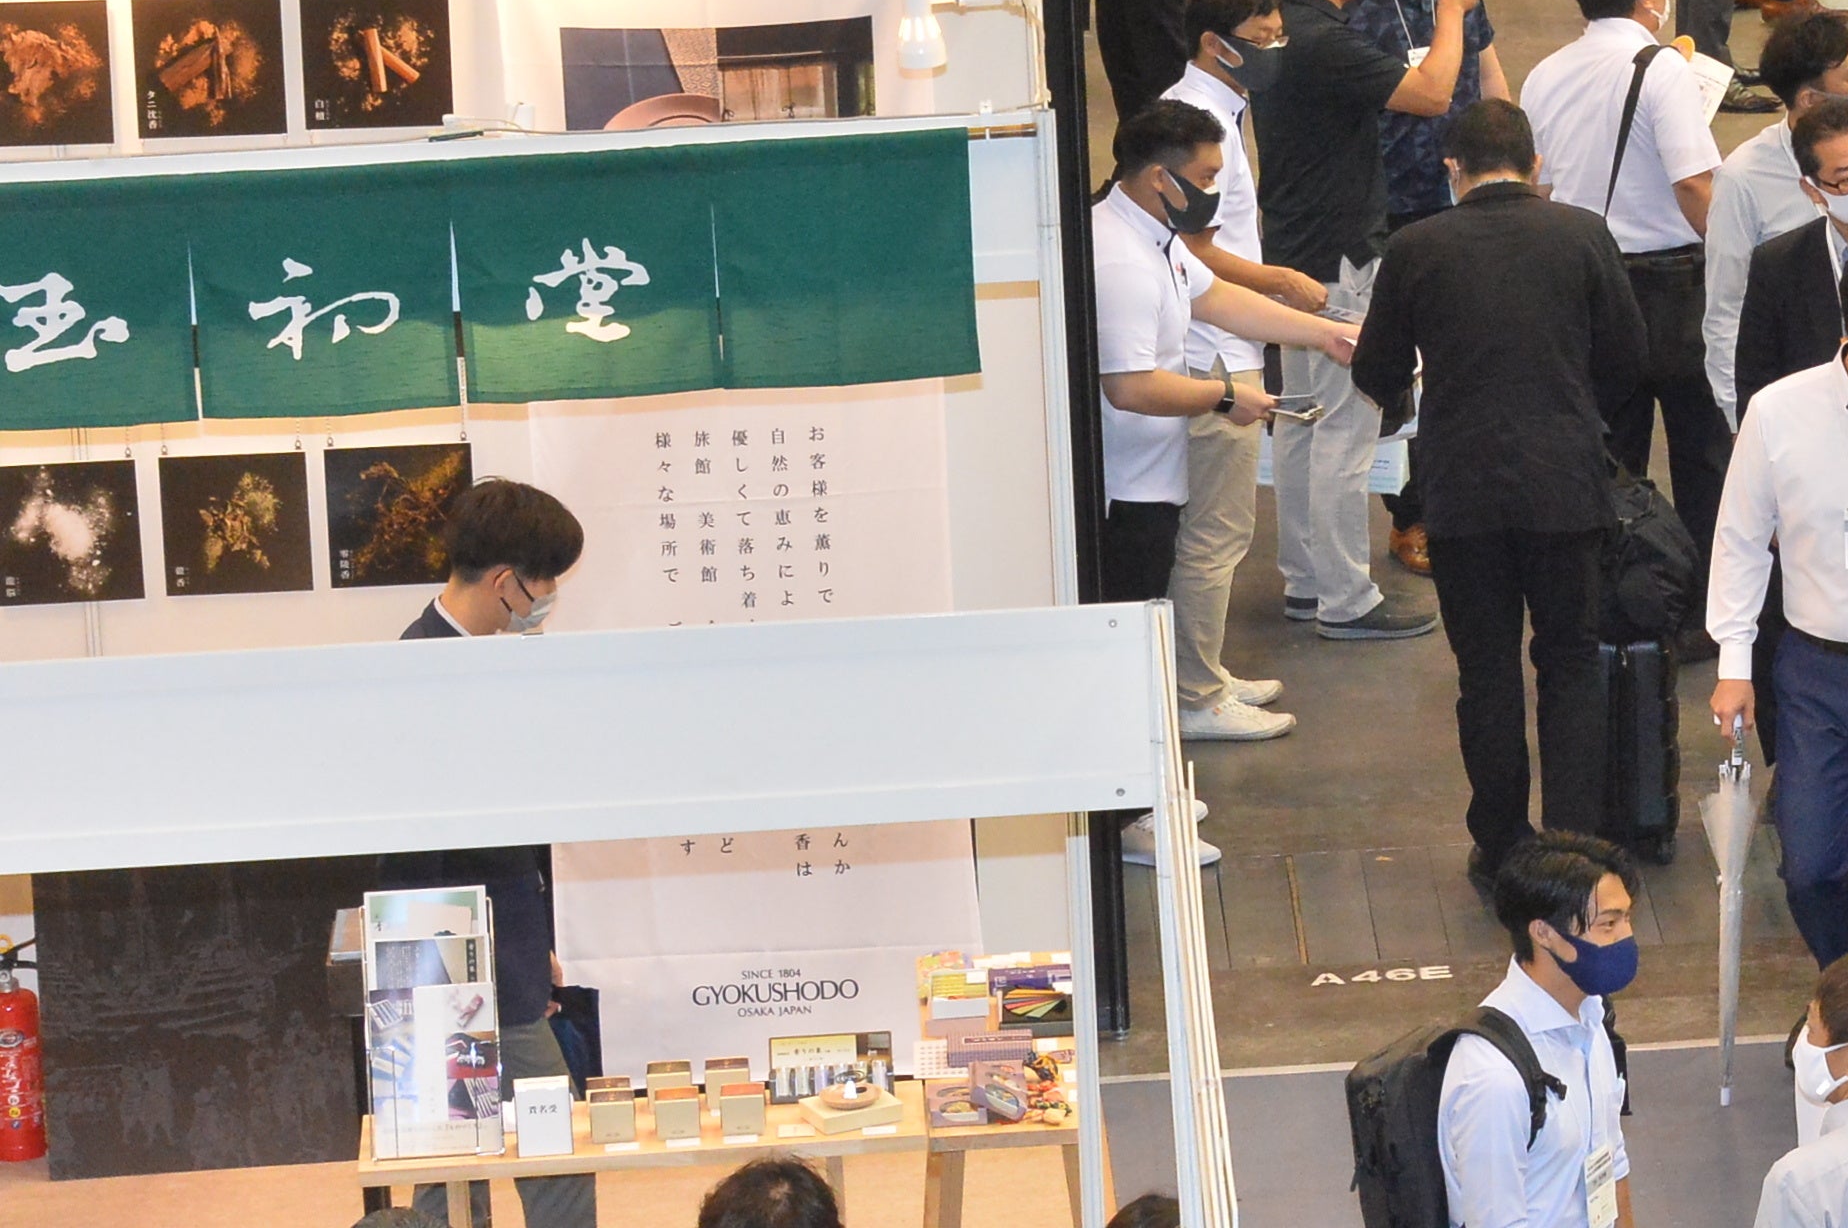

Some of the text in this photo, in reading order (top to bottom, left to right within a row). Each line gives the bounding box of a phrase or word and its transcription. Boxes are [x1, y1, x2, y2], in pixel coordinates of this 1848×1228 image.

[680, 838, 696, 856] す
[719, 837, 735, 855] ど
[794, 833, 814, 877] 香は
[741, 968, 801, 980] SINCE 1804
[1311, 965, 1454, 987] A46E
[691, 978, 859, 1007] GYOKUSHODO
[737, 1005, 812, 1018] OSAKA JAPAN
